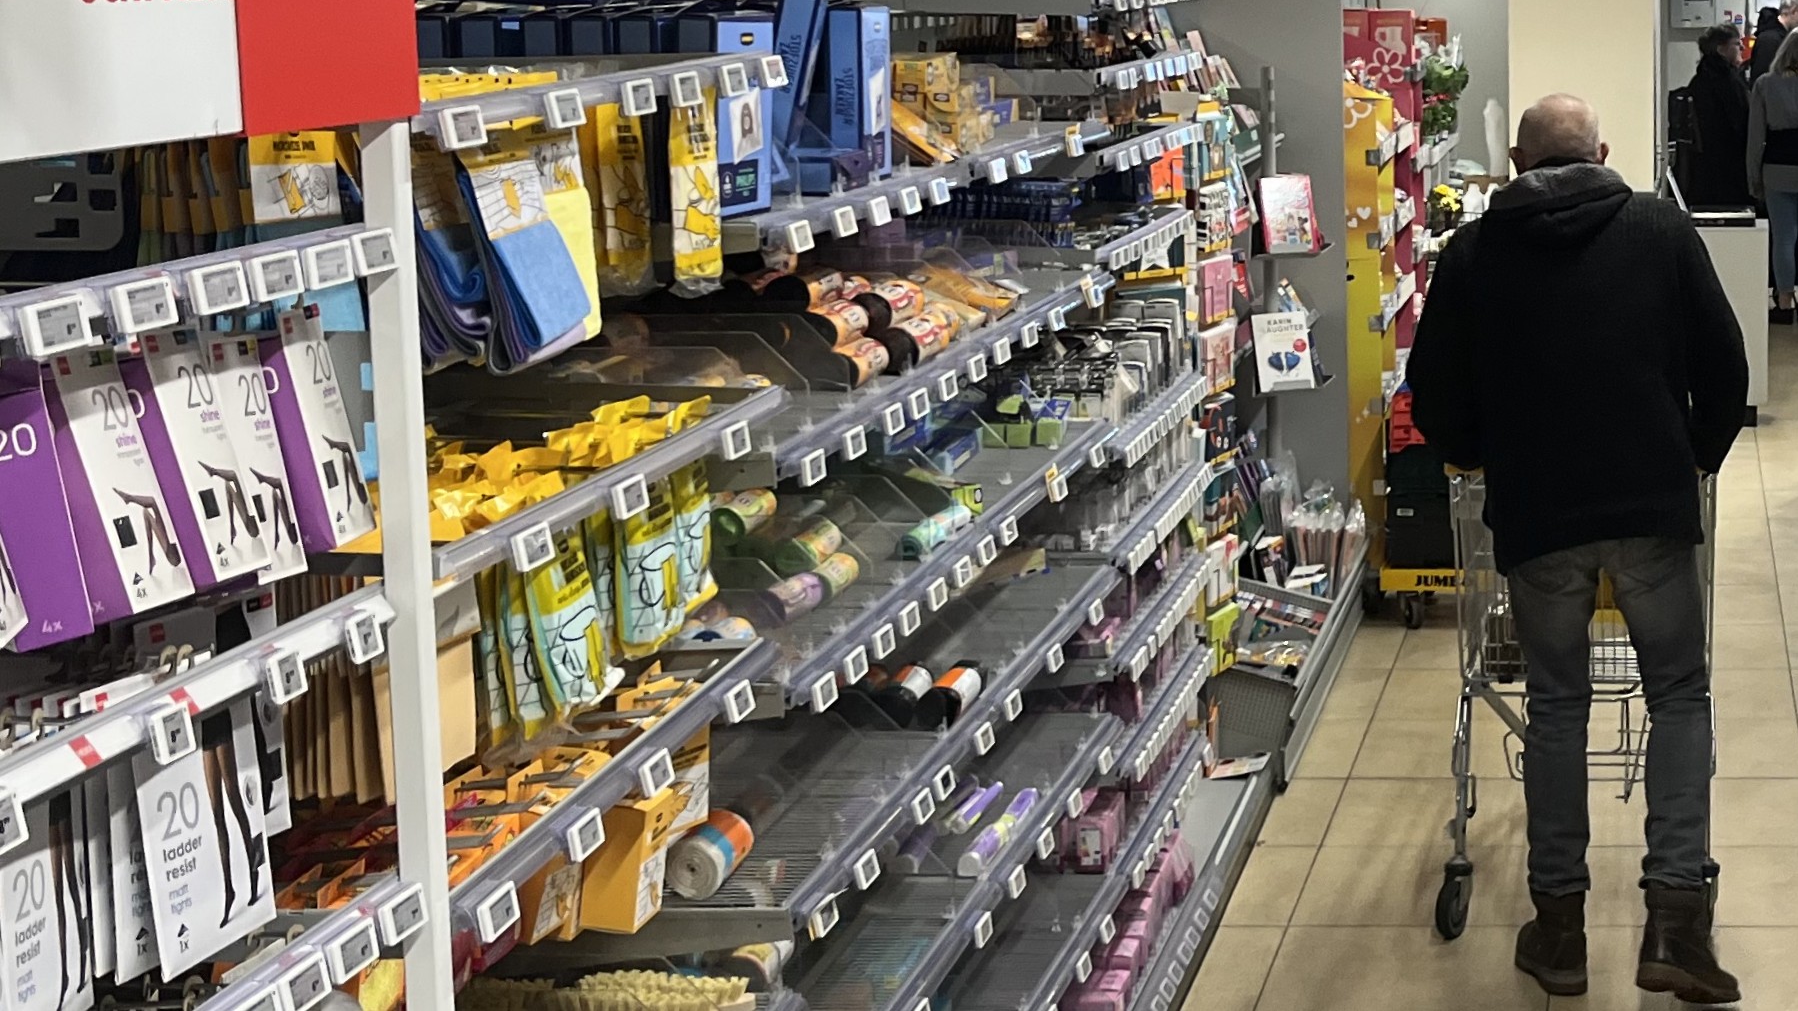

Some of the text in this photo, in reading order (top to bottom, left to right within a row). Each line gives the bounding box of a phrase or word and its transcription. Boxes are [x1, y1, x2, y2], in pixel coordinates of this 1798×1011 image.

[306, 340, 332, 385] 20
[91, 385, 129, 431] 20
[177, 363, 214, 409] 20
[238, 373, 267, 417] 20
[156, 781, 200, 841] 20
[162, 834, 203, 863] ladder
[165, 859, 198, 882] resist
[12, 859, 46, 923] 20
[15, 915, 47, 948] ladder
[16, 940, 43, 969] resist
